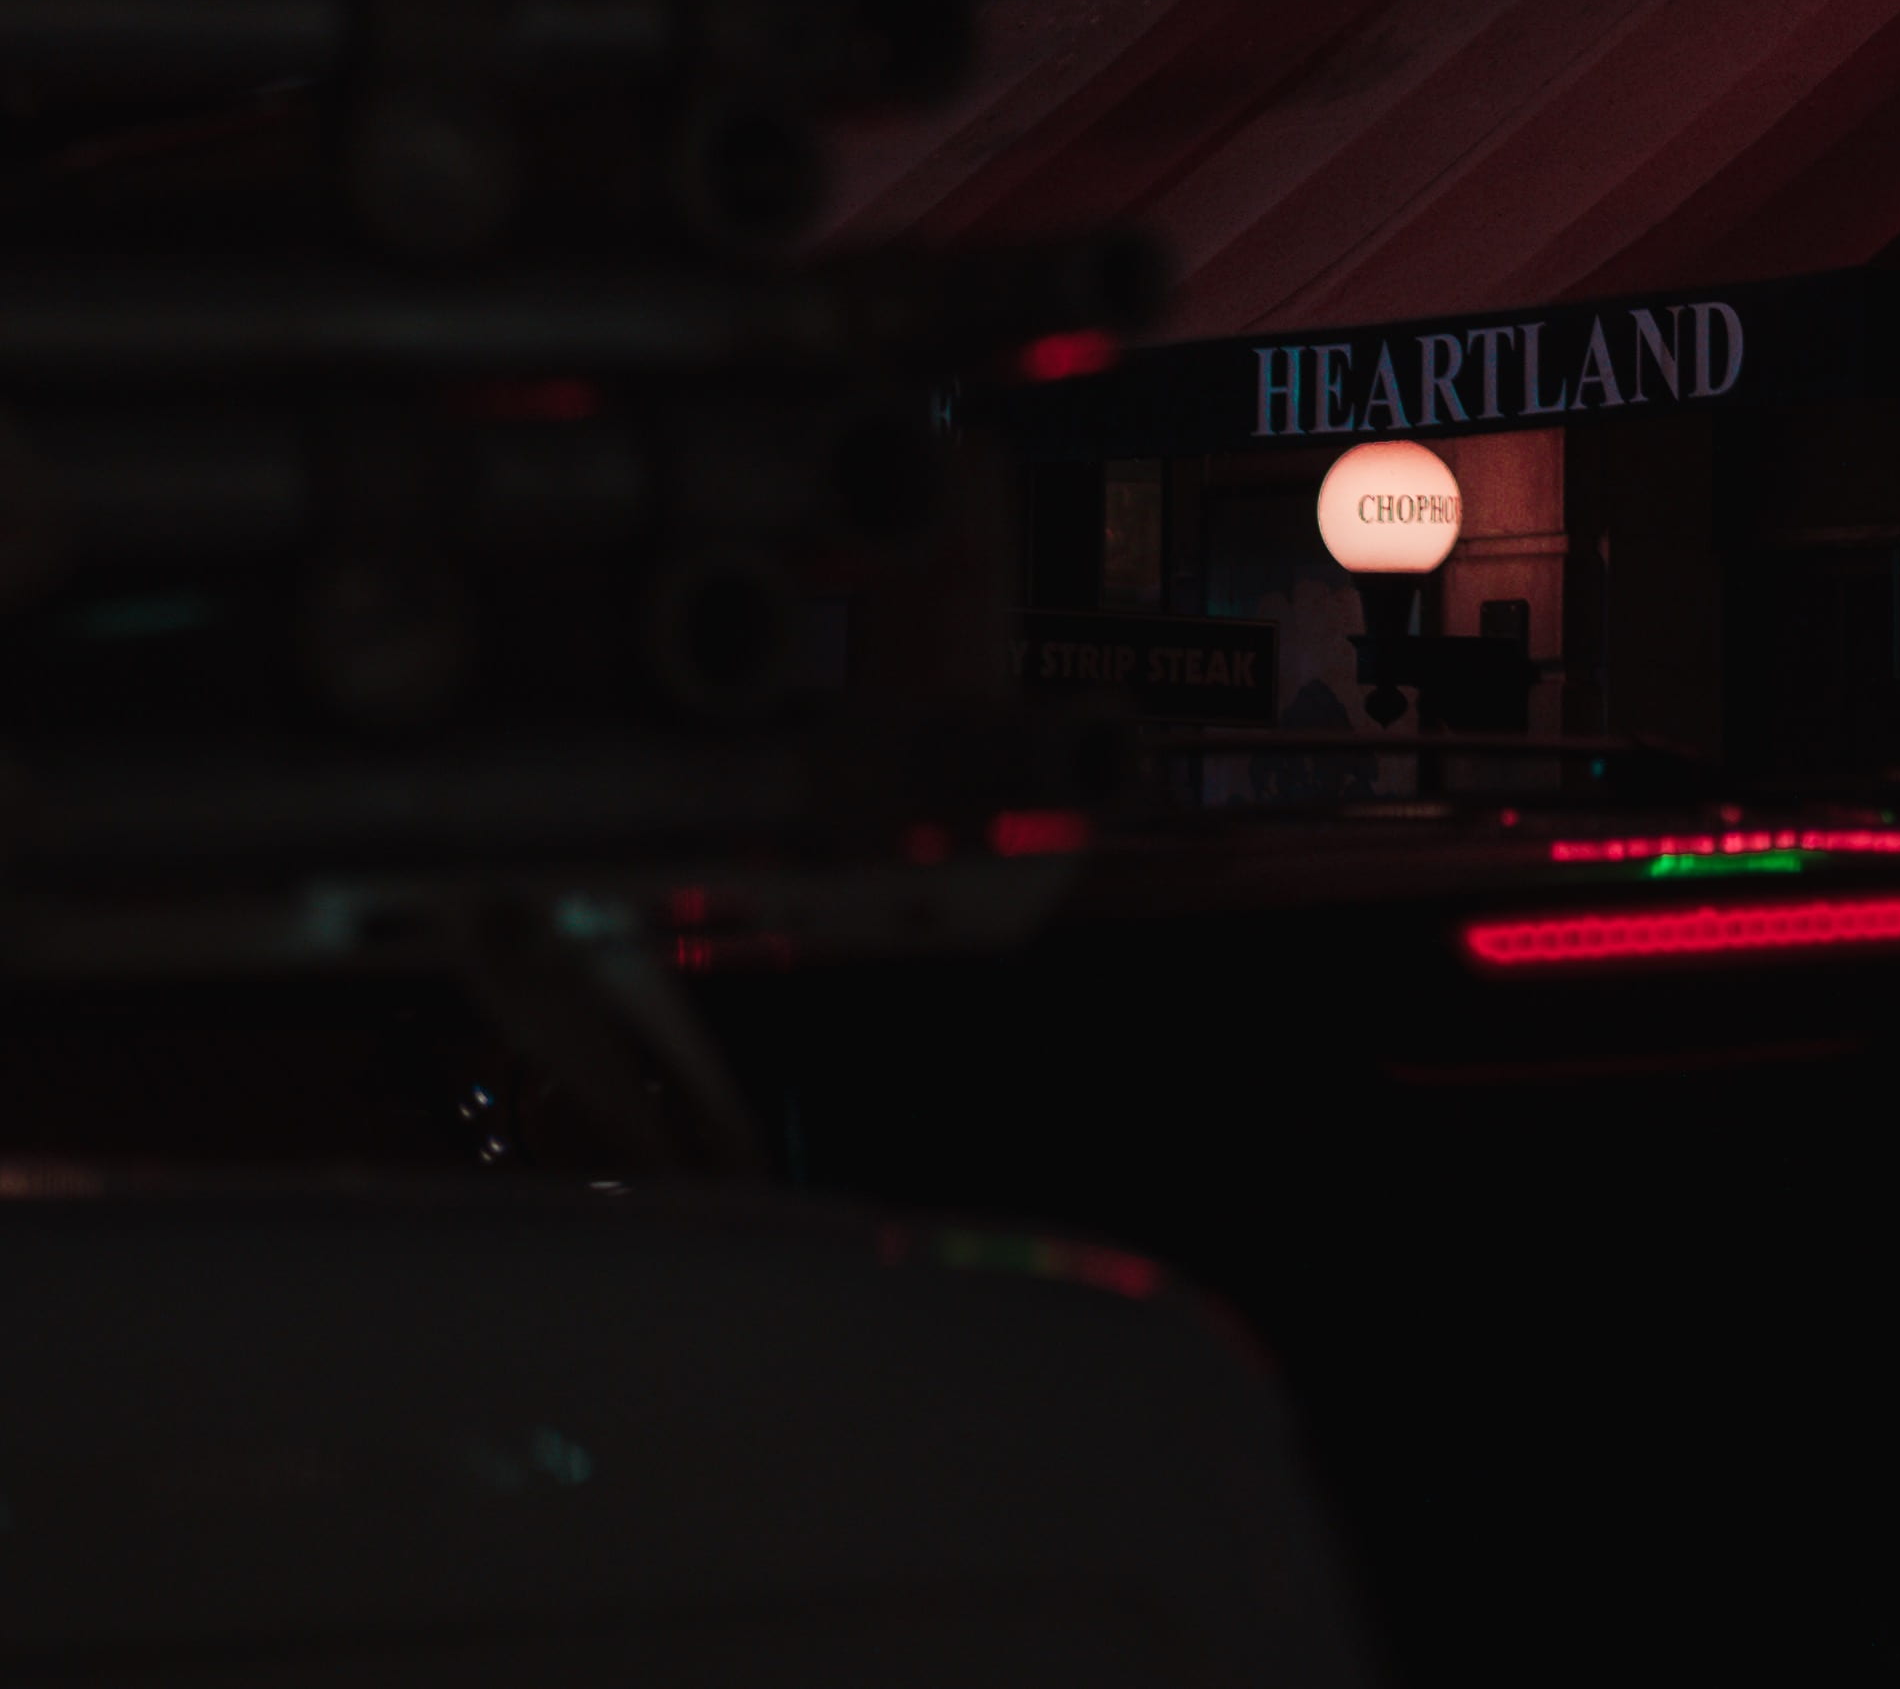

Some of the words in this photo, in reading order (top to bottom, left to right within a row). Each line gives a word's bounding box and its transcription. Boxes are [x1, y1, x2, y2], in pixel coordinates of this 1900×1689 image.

[1250, 301, 1745, 437] HEARTLAND
[1041, 640, 1136, 682] STRIP
[1146, 647, 1258, 688] STEAK
